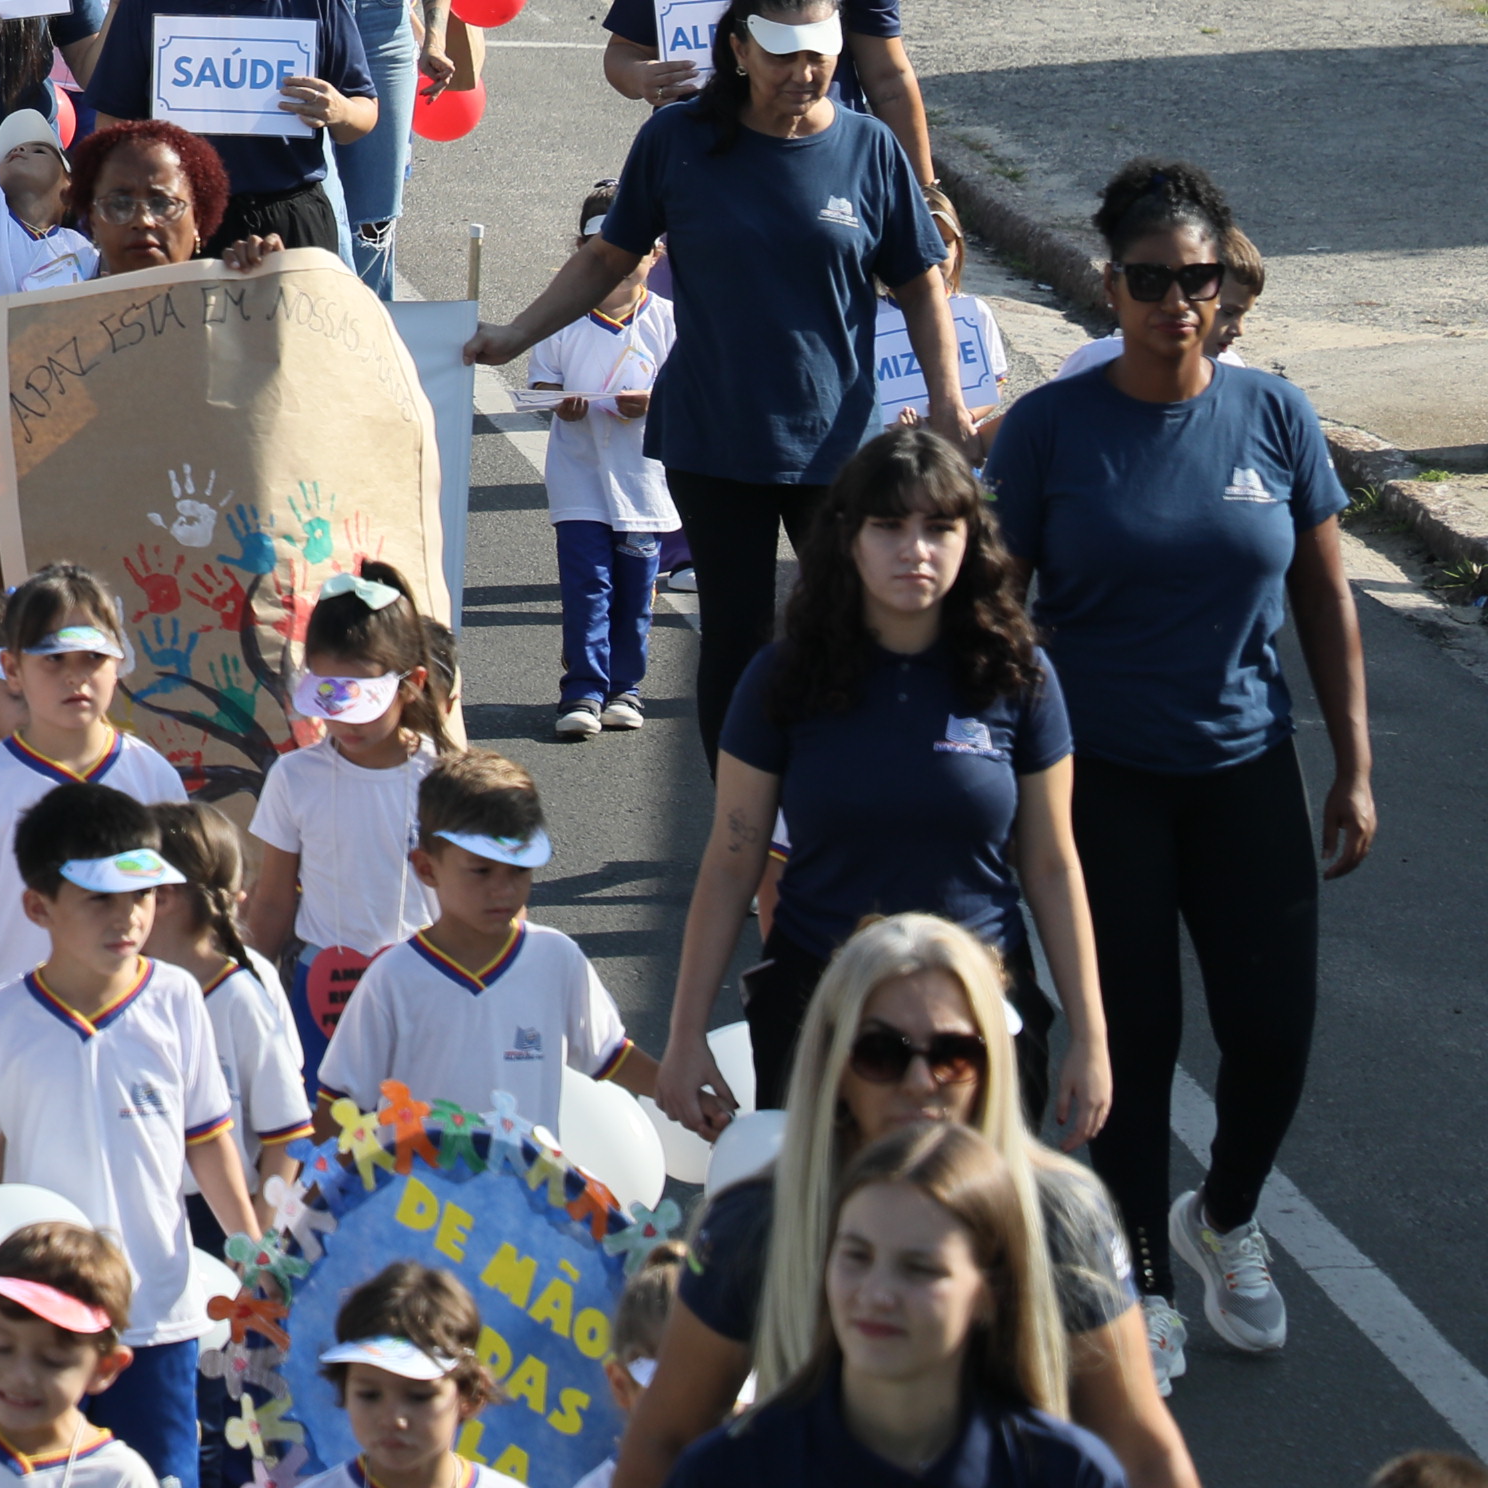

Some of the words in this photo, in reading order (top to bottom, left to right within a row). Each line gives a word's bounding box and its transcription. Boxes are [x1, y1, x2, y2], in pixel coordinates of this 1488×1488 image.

[171, 47, 295, 90] SAÚDE
[99, 285, 187, 354] ESTÁ
[200, 285, 251, 325] EM
[394, 1174, 476, 1264] DE
